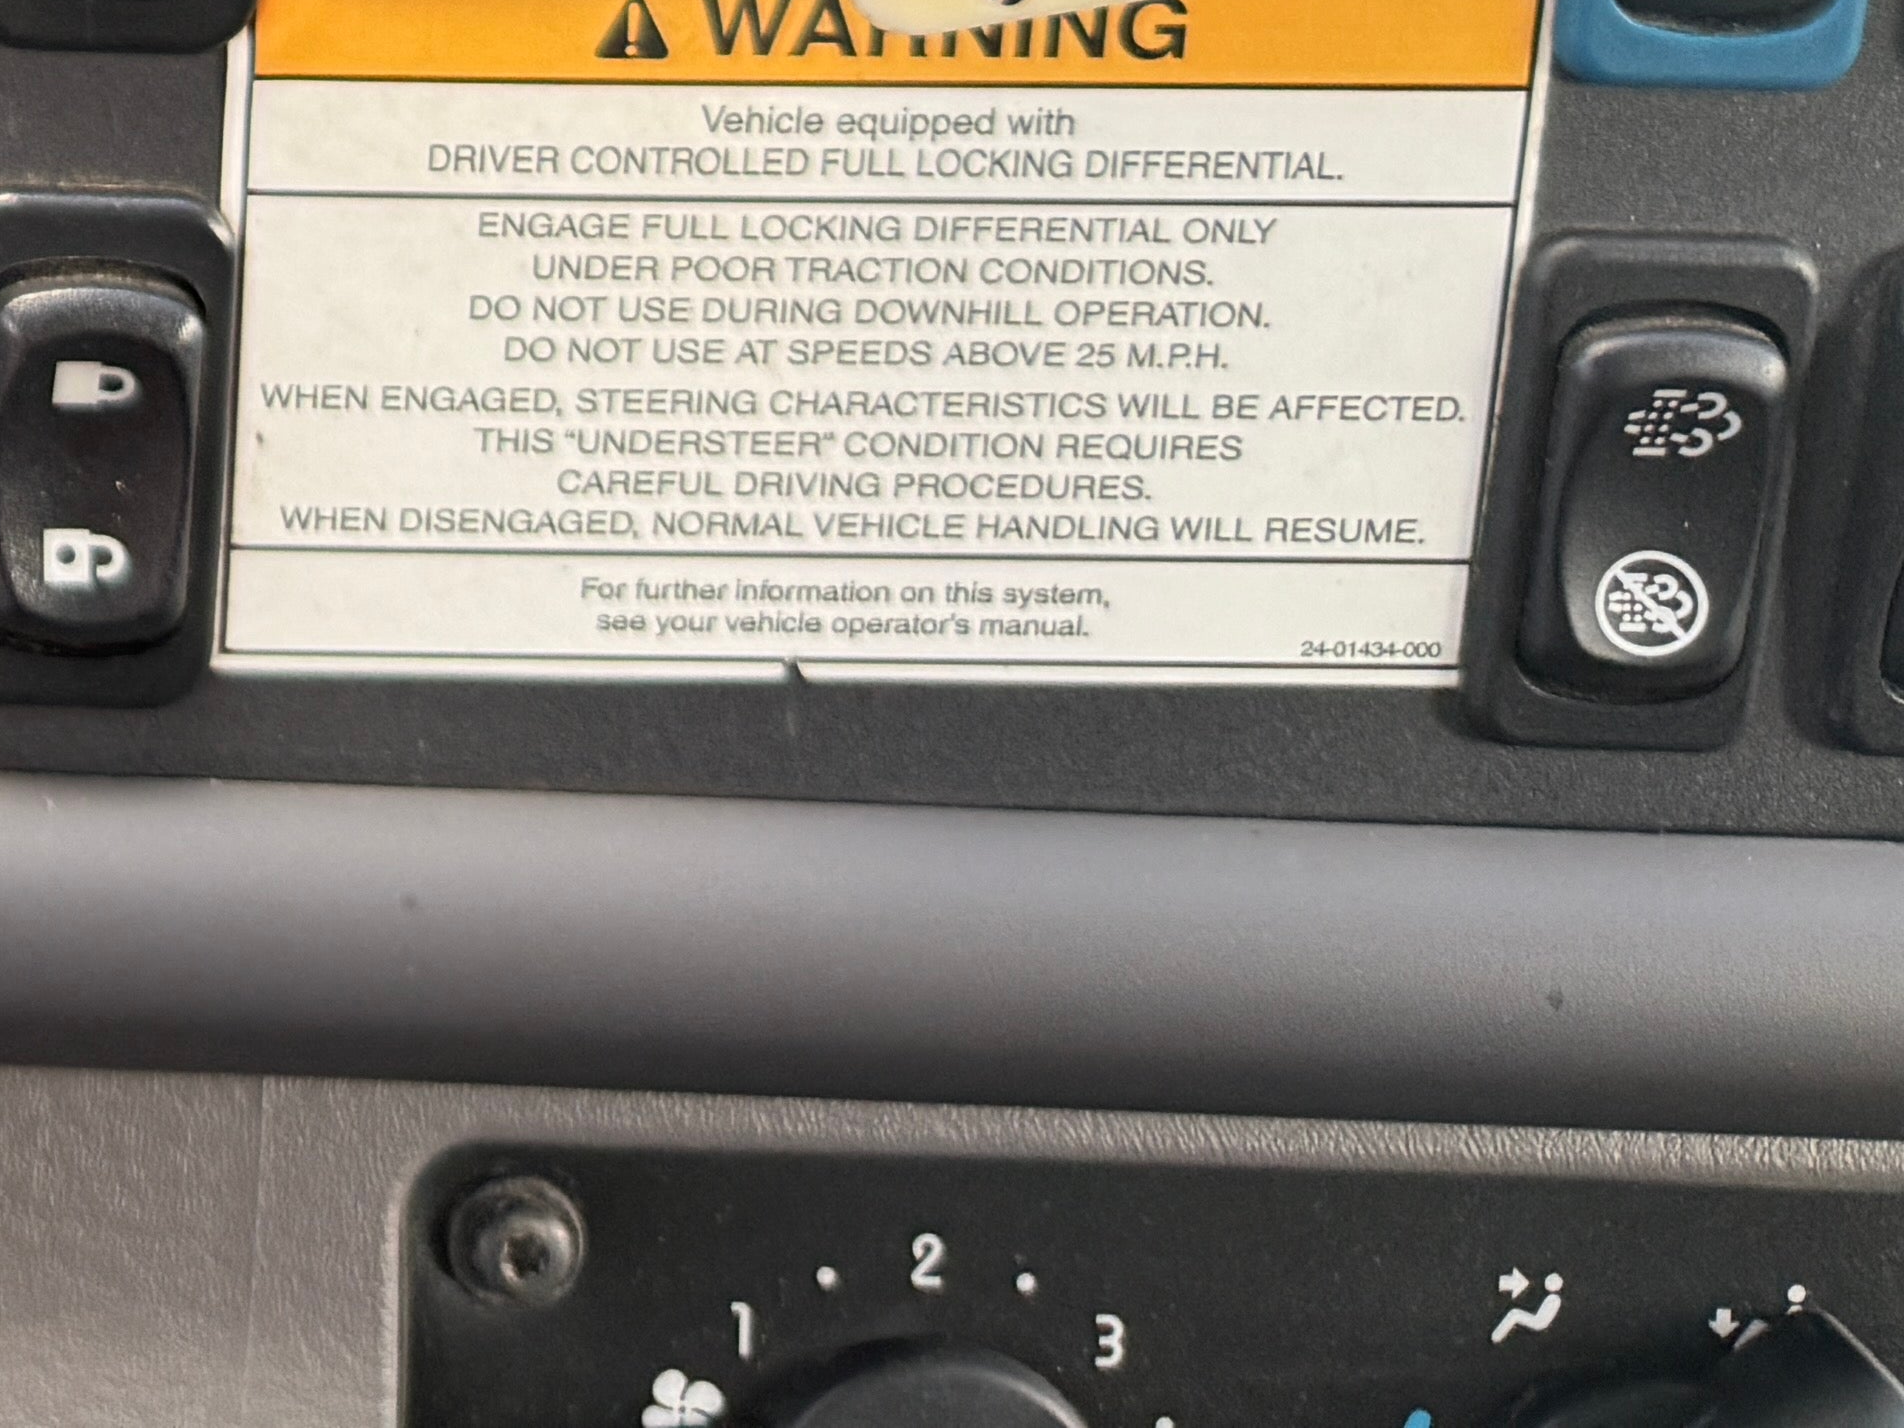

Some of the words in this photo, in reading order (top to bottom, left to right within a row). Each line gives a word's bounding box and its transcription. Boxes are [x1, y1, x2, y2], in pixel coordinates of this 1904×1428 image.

[701, 104, 824, 135] Vehicle
[837, 106, 994, 142] equipped
[1007, 108, 1076, 137] with
[428, 145, 559, 174] DRIVER
[570, 146, 809, 177] CONTROLLED
[821, 148, 905, 177] FULL
[917, 149, 1073, 180] LOCKING
[1085, 151, 1344, 181] DIFFERENTIAL.
[478, 212, 630, 240] ENGAGE
[642, 213, 729, 241] FULL
[741, 214, 901, 243] LOCKING
[914, 217, 1168, 245] DIFFERENTIAL
[1182, 218, 1278, 245] ONLY
[532, 255, 658, 281] UNDER
[672, 255, 776, 282] POOR
[785, 257, 967, 284] TRACTION
[979, 259, 1214, 287] CONDITIONS.
[469, 295, 521, 321] DO
[533, 295, 604, 322] NOT
[619, 297, 689, 323] USE
[702, 298, 843, 325] DURING
[855, 300, 1043, 327] DOWNHILL
[1053, 301, 1272, 330] OPERATION.
[504, 336, 554, 362] DO
[567, 337, 641, 363] NOT
[653, 338, 725, 364] USE
[735, 340, 776, 365] AT
[787, 340, 932, 367] SPEEDS
[943, 342, 1067, 368] ABOVE
[1074, 343, 1116, 369] 25
[1127, 344, 1229, 370] M.P.H.
[260, 383, 369, 411] WHEN
[381, 386, 562, 418] ENGAGED,
[575, 389, 757, 416] STEERING
[769, 390, 1107, 419] CHARACTERISTICS
[1118, 394, 1200, 421] WILL
[1212, 395, 1260, 421] BE
[1268, 395, 1466, 423] AFFECTED.
[475, 428, 554, 454] THIS
[843, 431, 1044, 459] CONDITION
[1056, 434, 1244, 461] REQUIRES
[556, 469, 722, 496] CAREFUL
[735, 471, 880, 498] DRIVING
[894, 473, 1152, 502] PROCEDURES.
[280, 506, 387, 532] WHEN
[399, 507, 640, 540] DISENGAGED,
[652, 511, 804, 538] NORMAL
[814, 512, 965, 540] VEHICLE
[976, 514, 1160, 543] HANDLING
[1171, 517, 1253, 544] WILL
[1265, 518, 1426, 545] RESUME.
[580, 577, 623, 601] For
[635, 577, 728, 602] further
[735, 578, 890, 604] information
[900, 584, 935, 605] on
[944, 580, 993, 605] this
[1002, 583, 1111, 610] system,
[596, 614, 646, 632] see
[655, 614, 718, 638] your
[725, 610, 821, 634] vehicle
[831, 612, 970, 640] operator's
[979, 613, 1089, 637] manual.
[1300, 640, 1442, 660] 24-01434-000
[910, 1232, 946, 1291] 2
[730, 1301, 755, 1359] 1
[1093, 1312, 1126, 1370] 3
